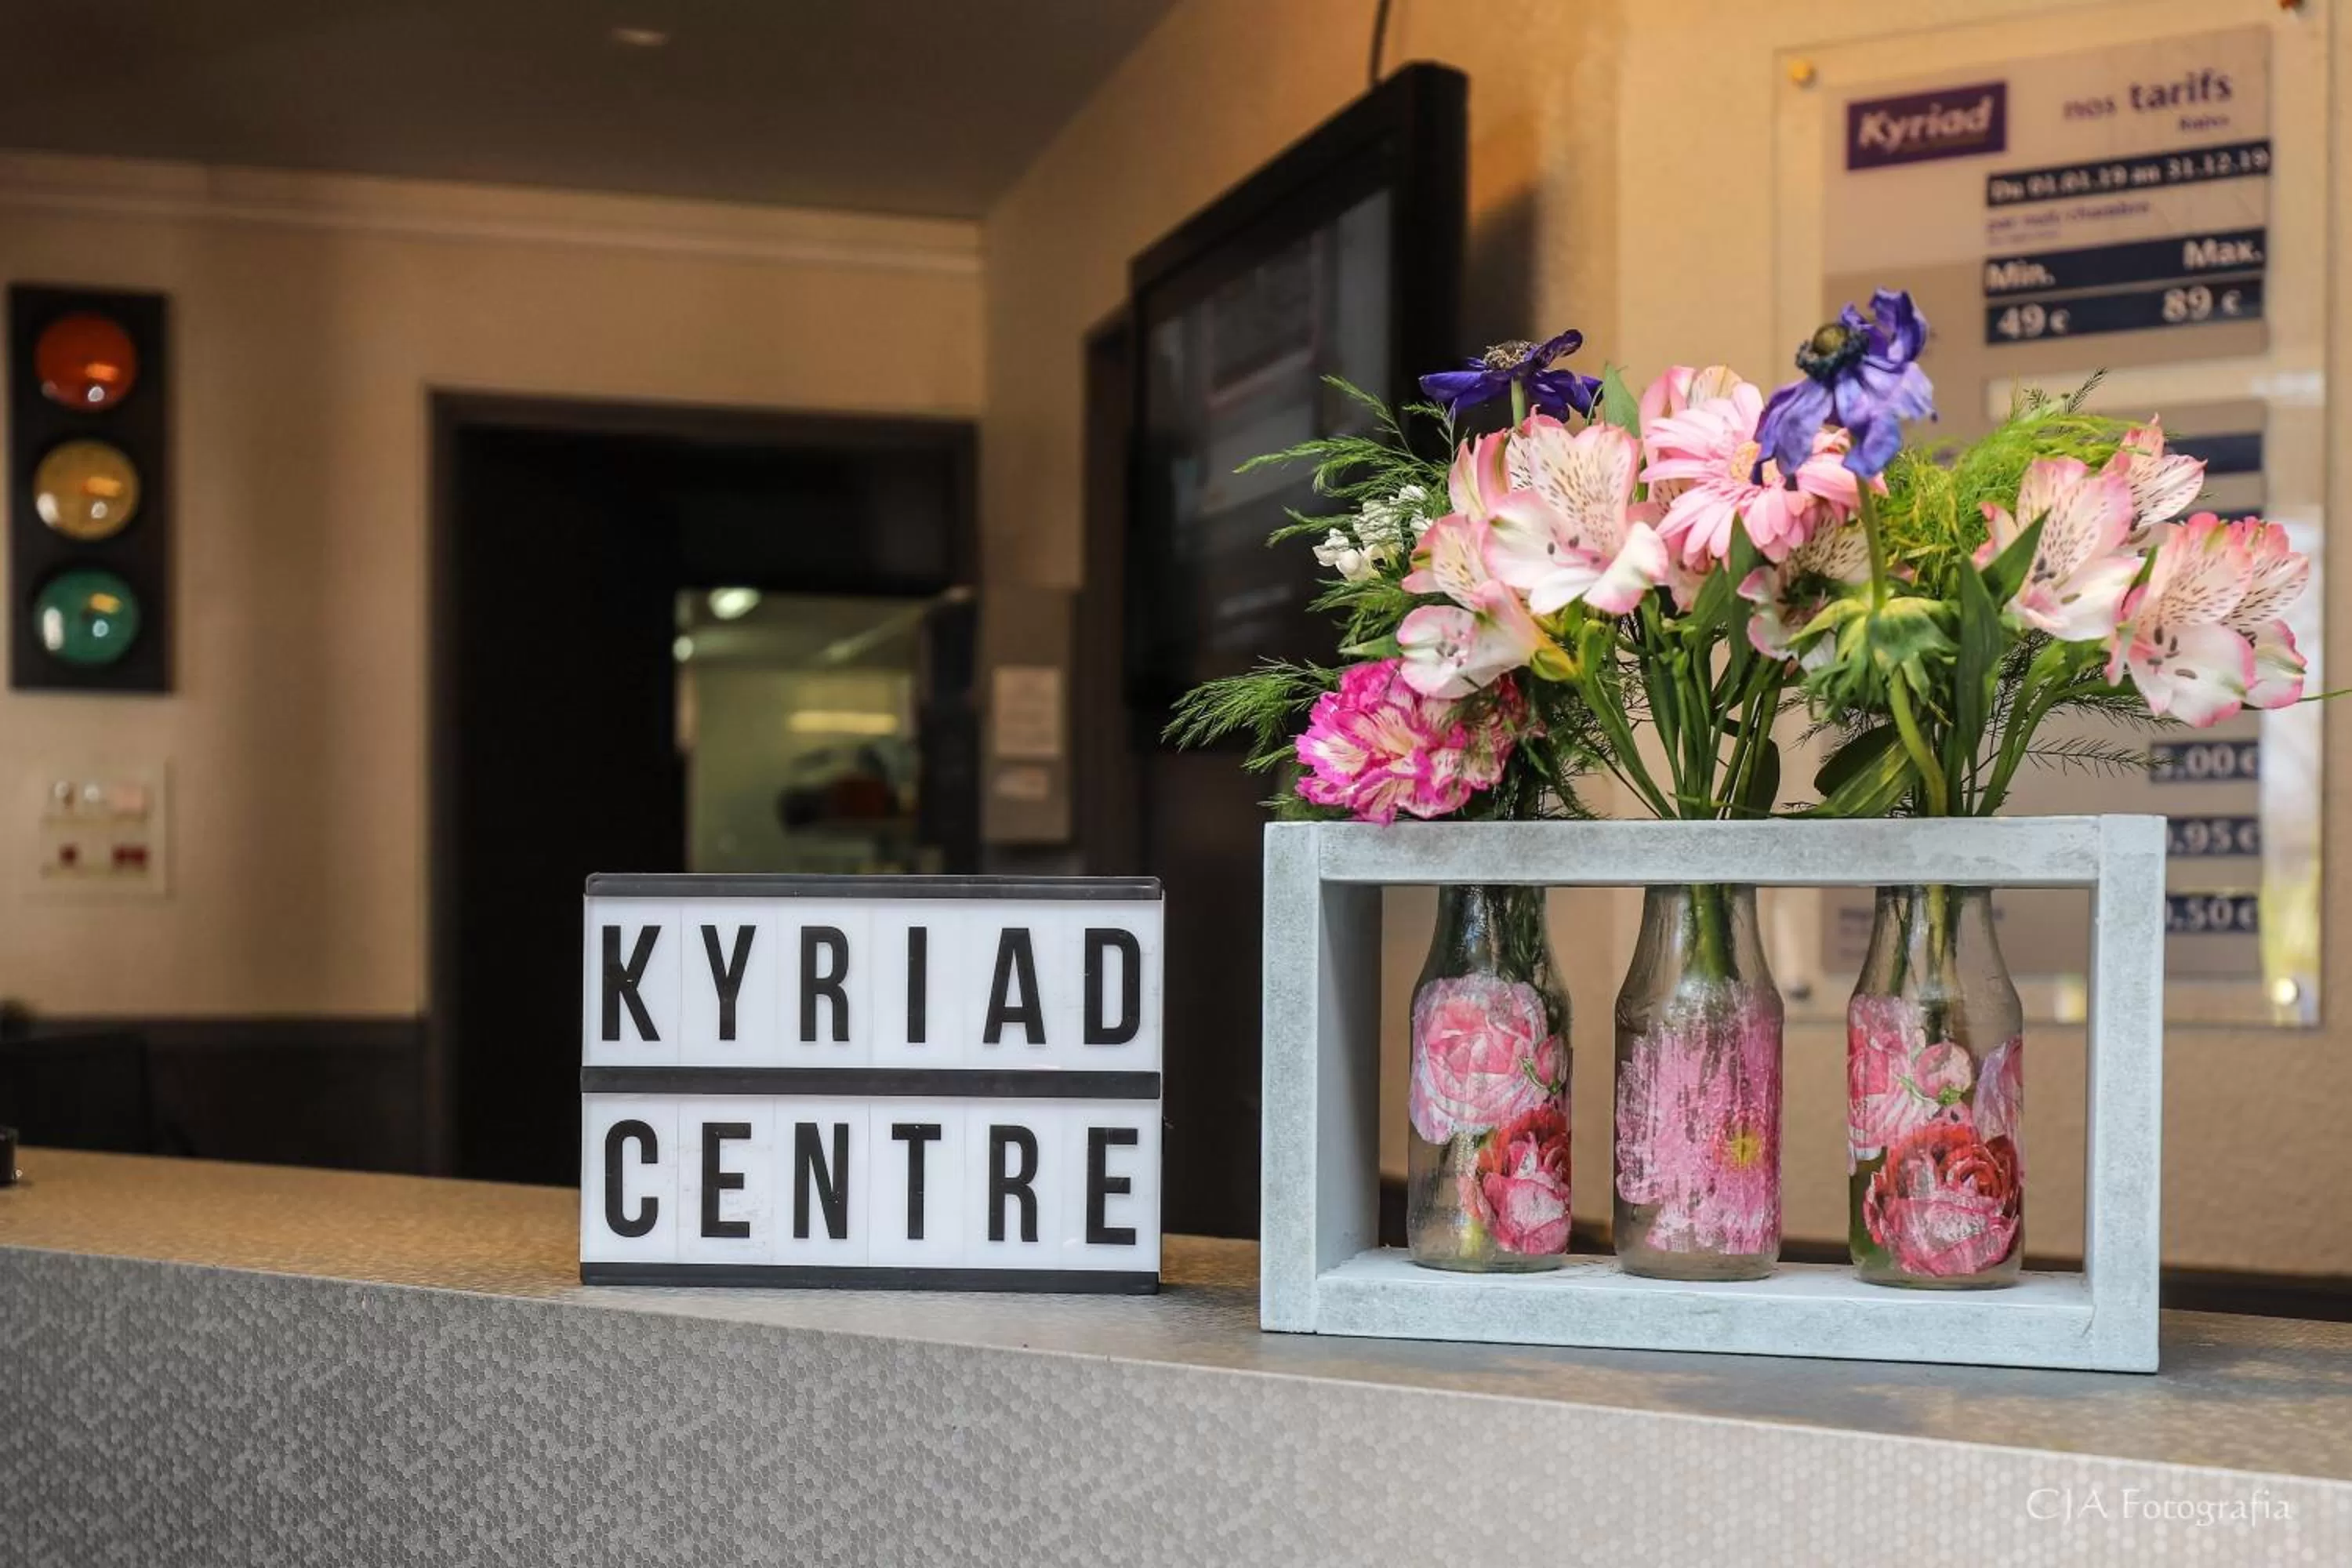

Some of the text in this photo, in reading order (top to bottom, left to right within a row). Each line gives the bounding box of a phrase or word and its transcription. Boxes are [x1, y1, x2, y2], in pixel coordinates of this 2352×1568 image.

[2128, 67, 2233, 111] tarifs
[1858, 94, 1994, 155] Kyriad
[1986, 238, 2263, 290] Min. Max.
[2162, 286, 2213, 322] 89
[2166, 821, 2233, 854] .95
[2165, 896, 2234, 931] .50
[601, 924, 1142, 1045] KYRIAD
[604, 1119, 1139, 1245] CENTRE
